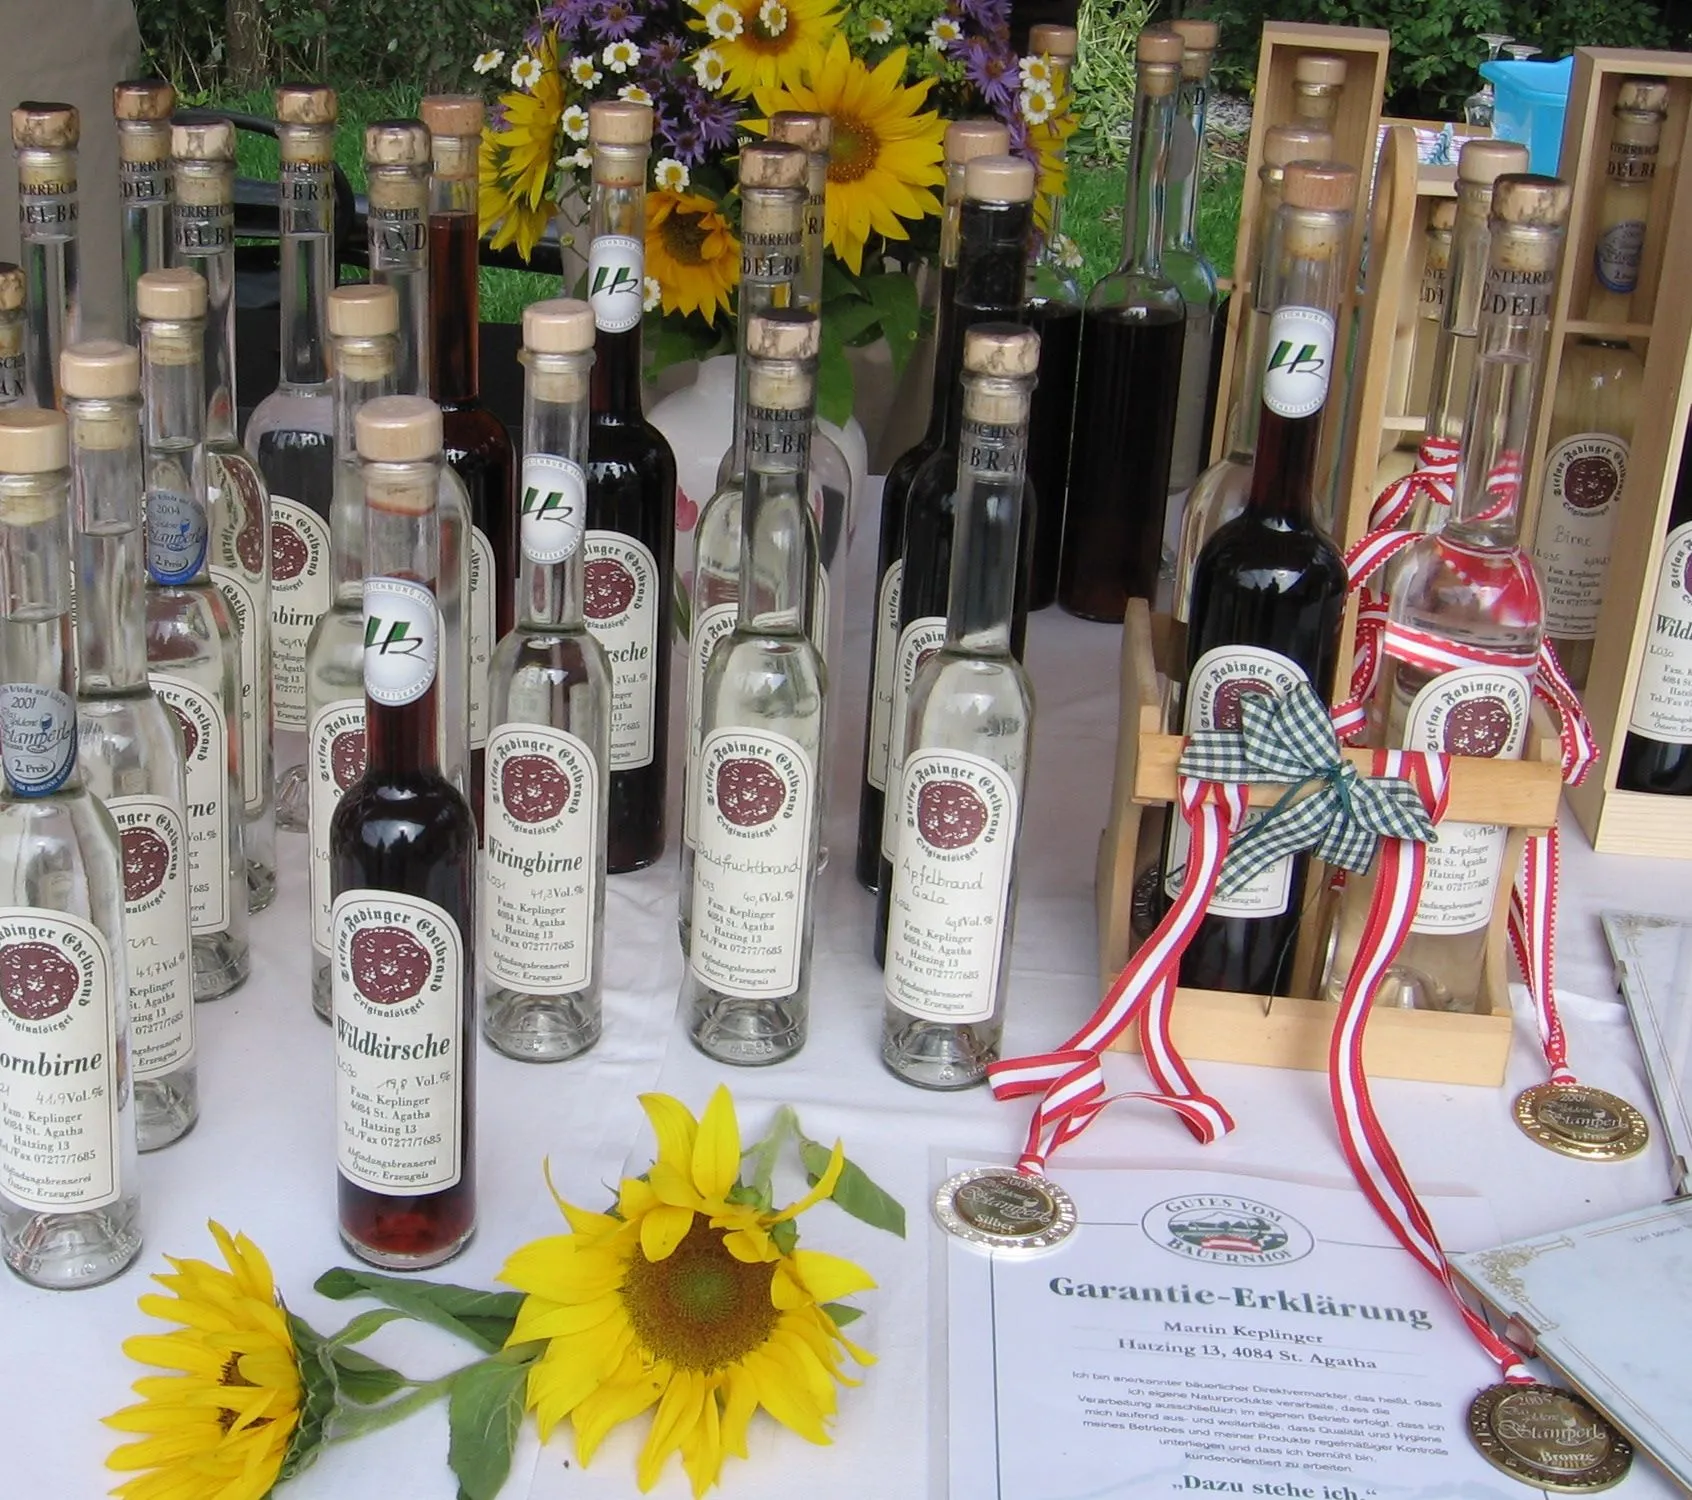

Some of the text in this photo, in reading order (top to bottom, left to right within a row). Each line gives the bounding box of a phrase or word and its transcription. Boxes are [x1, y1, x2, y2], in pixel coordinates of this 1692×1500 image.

[1554, 524, 1592, 547] Birne
[11, 697, 37, 709] 2001
[26, 763, 48, 773] Preis
[488, 834, 583, 877] Wiringbirne
[903, 857, 983, 889] Apfelbrand
[912, 886, 949, 905] Gala
[520, 902, 566, 916] Keplinger
[730, 905, 775, 919] Keplinger
[505, 924, 554, 940] Hatzing 13
[532, 918, 566, 928] Agatha
[742, 922, 774, 932] Agatha
[522, 940, 575, 951] 07277/7685
[927, 929, 973, 944] Keplinger
[416, 918, 447, 992] Edelbrand
[938, 945, 972, 956] Agatha
[62, 933, 95, 1007] Edelbrand
[129, 979, 175, 999] Keplinger
[144, 992, 175, 1008] Agatha
[156, 1008, 166, 1018] 13
[337, 1014, 450, 1060] Wildkirsche
[350, 1085, 431, 1109] Fam. Keplinger
[3, 1102, 83, 1125] Fam. Keplinger
[373, 1107, 388, 1120] St.
[392, 1109, 431, 1123] Agatha
[25, 1124, 83, 1139] St. Agatha
[360, 1117, 417, 1136] Hatzing 13
[14, 1135, 70, 1153] Hatzing 13
[380, 1133, 442, 1148] 07277/7685
[34, 1149, 96, 1164] 07277/7685
[382, 1171, 429, 1183] Erzeugnis
[1165, 1198, 1282, 1222] GUTES VOM
[1166, 1237, 1292, 1263] BAUERNHOF
[1049, 1276, 1433, 1331] Garantie-Erklärung
[1164, 1321, 1323, 1344] Martin Keplinger
[1118, 1338, 1377, 1369] Hatzing 13, 4084 St. Agatha
[1072, 1371, 1090, 1380] Ich
[1092, 1373, 1110, 1381] bin
[1113, 1376, 1182, 1387] anerkannter
[1185, 1381, 1249, 1392] bäuerlicher
[1354, 1394, 1376, 1403] das
[1414, 1399, 1443, 1408] dass
[1128, 1388, 1145, 1396] ich
[1148, 1390, 1187, 1401] eigene
[1190, 1392, 1273, 1405] Naturprodukte
[1341, 1405, 1369, 1414] dass
[1372, 1407, 1390, 1415] die
[1078, 1394, 1152, 1409] Verarbeitung
[1240, 1407, 1255, 1416] im
[1258, 1411, 1304, 1421] eigenen
[1308, 1413, 1350, 1424] Betrieb
[1397, 1421, 1424, 1430] dass
[1427, 1423, 1445, 1431] ich
[1085, 1408, 1112, 1417] mich
[1116, 1411, 1159, 1420] laufend
[1192, 1417, 1214, 1425] und
[1288, 1424, 1315, 1433] dass
[1319, 1426, 1365, 1437] Qualität
[1368, 1431, 1390, 1439] und
[1083, 1420, 1125, 1429] meines
[1129, 1423, 1184, 1434] Betriebes
[1214, 1431, 1254, 1440] meiner
[1258, 1434, 1311, 1444] Produkte
[1396, 1445, 1448, 1455] Kontrolle
[1159, 1438, 1224, 1450] unterliegen
[1229, 1444, 1250, 1452] und
[1254, 1446, 1282, 1455] dass
[1286, 1448, 1303, 1456] ich
[1185, 1452, 1281, 1467] kundenorientiert
[1539, 1451, 1597, 1466] Bronze
[1253, 1482, 1315, 1499] stehe
